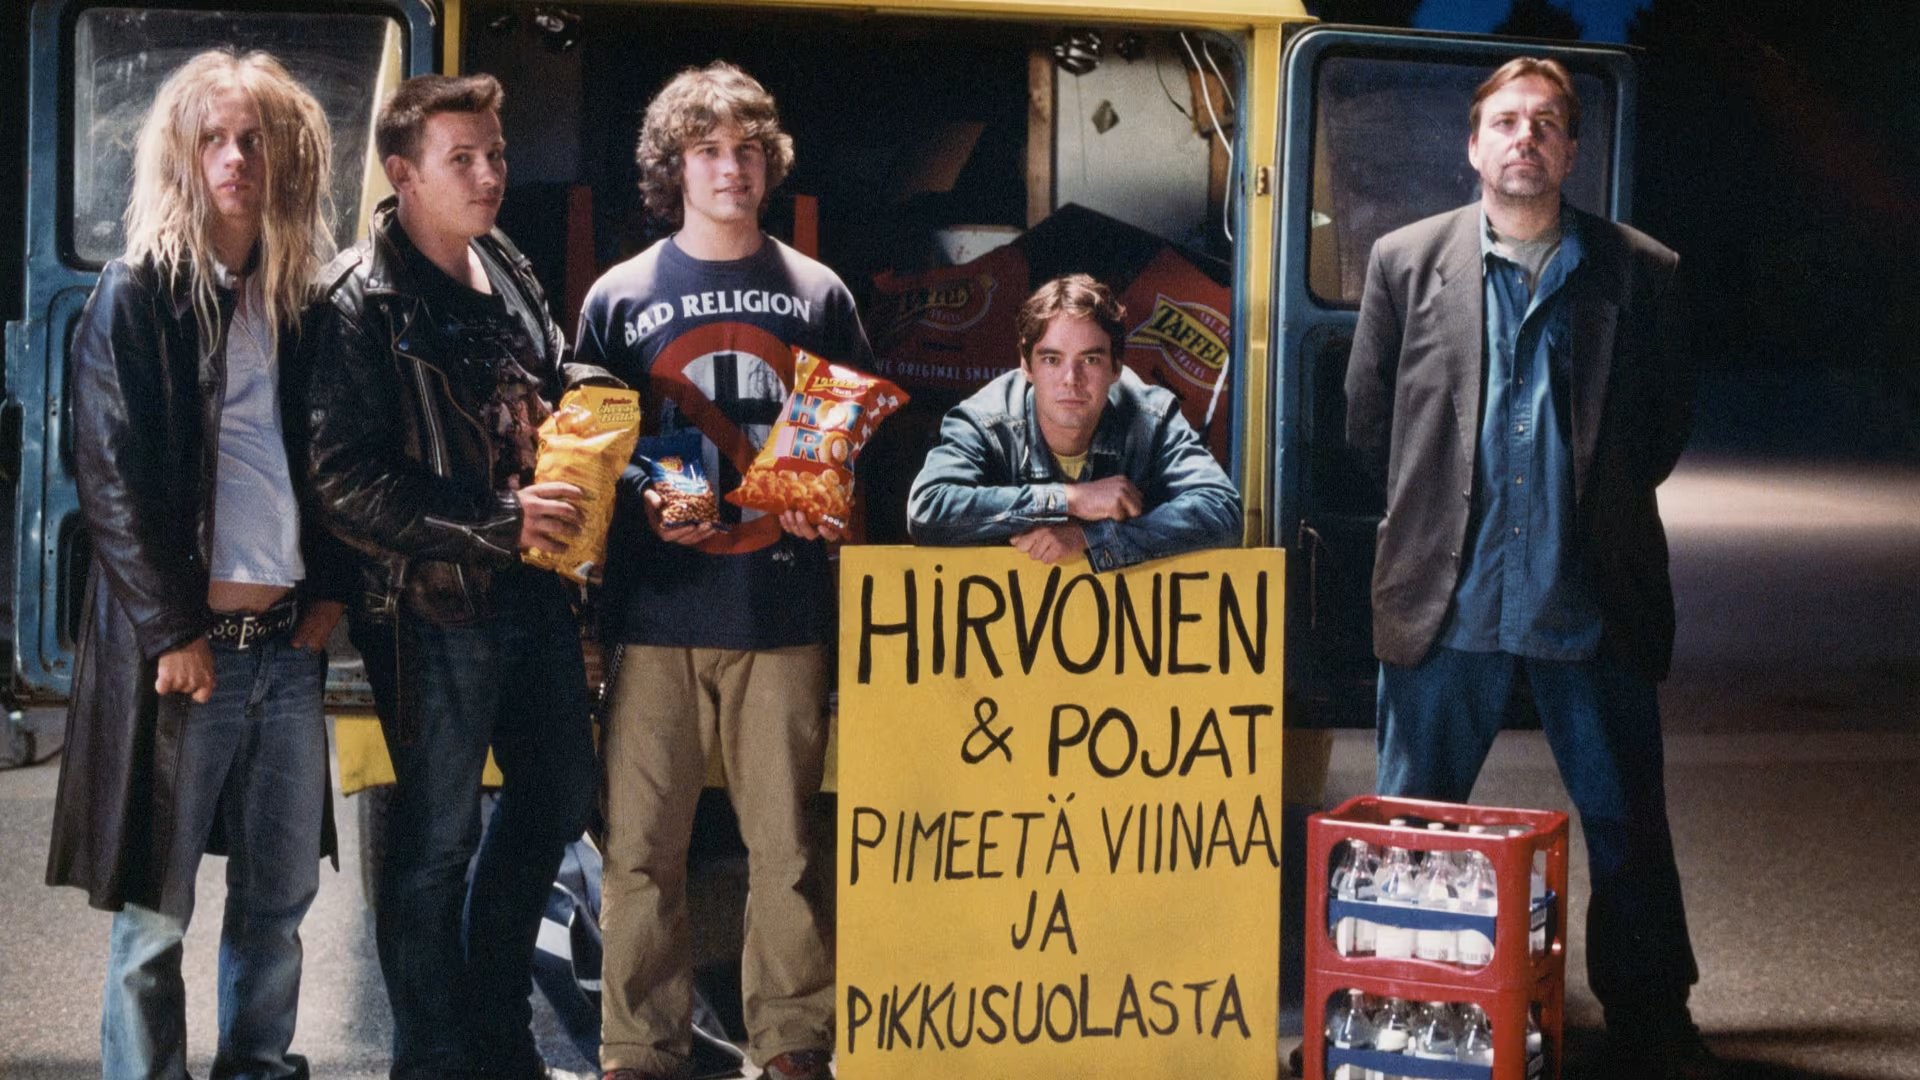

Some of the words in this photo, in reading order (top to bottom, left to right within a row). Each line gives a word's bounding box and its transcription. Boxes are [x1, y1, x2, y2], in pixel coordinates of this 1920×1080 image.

[624, 302, 675, 347] BAD
[681, 290, 812, 323] RELIGION
[897, 360, 961, 379] ORIGINAL
[960, 697, 1014, 765] &
[1048, 703, 1274, 778] POJAT
[850, 792, 1080, 886] PIMEETÄ
[1101, 794, 1280, 875] VIINAA
[1011, 889, 1078, 954] JA
[848, 973, 1251, 1054] PIKKUSUOLASTA
